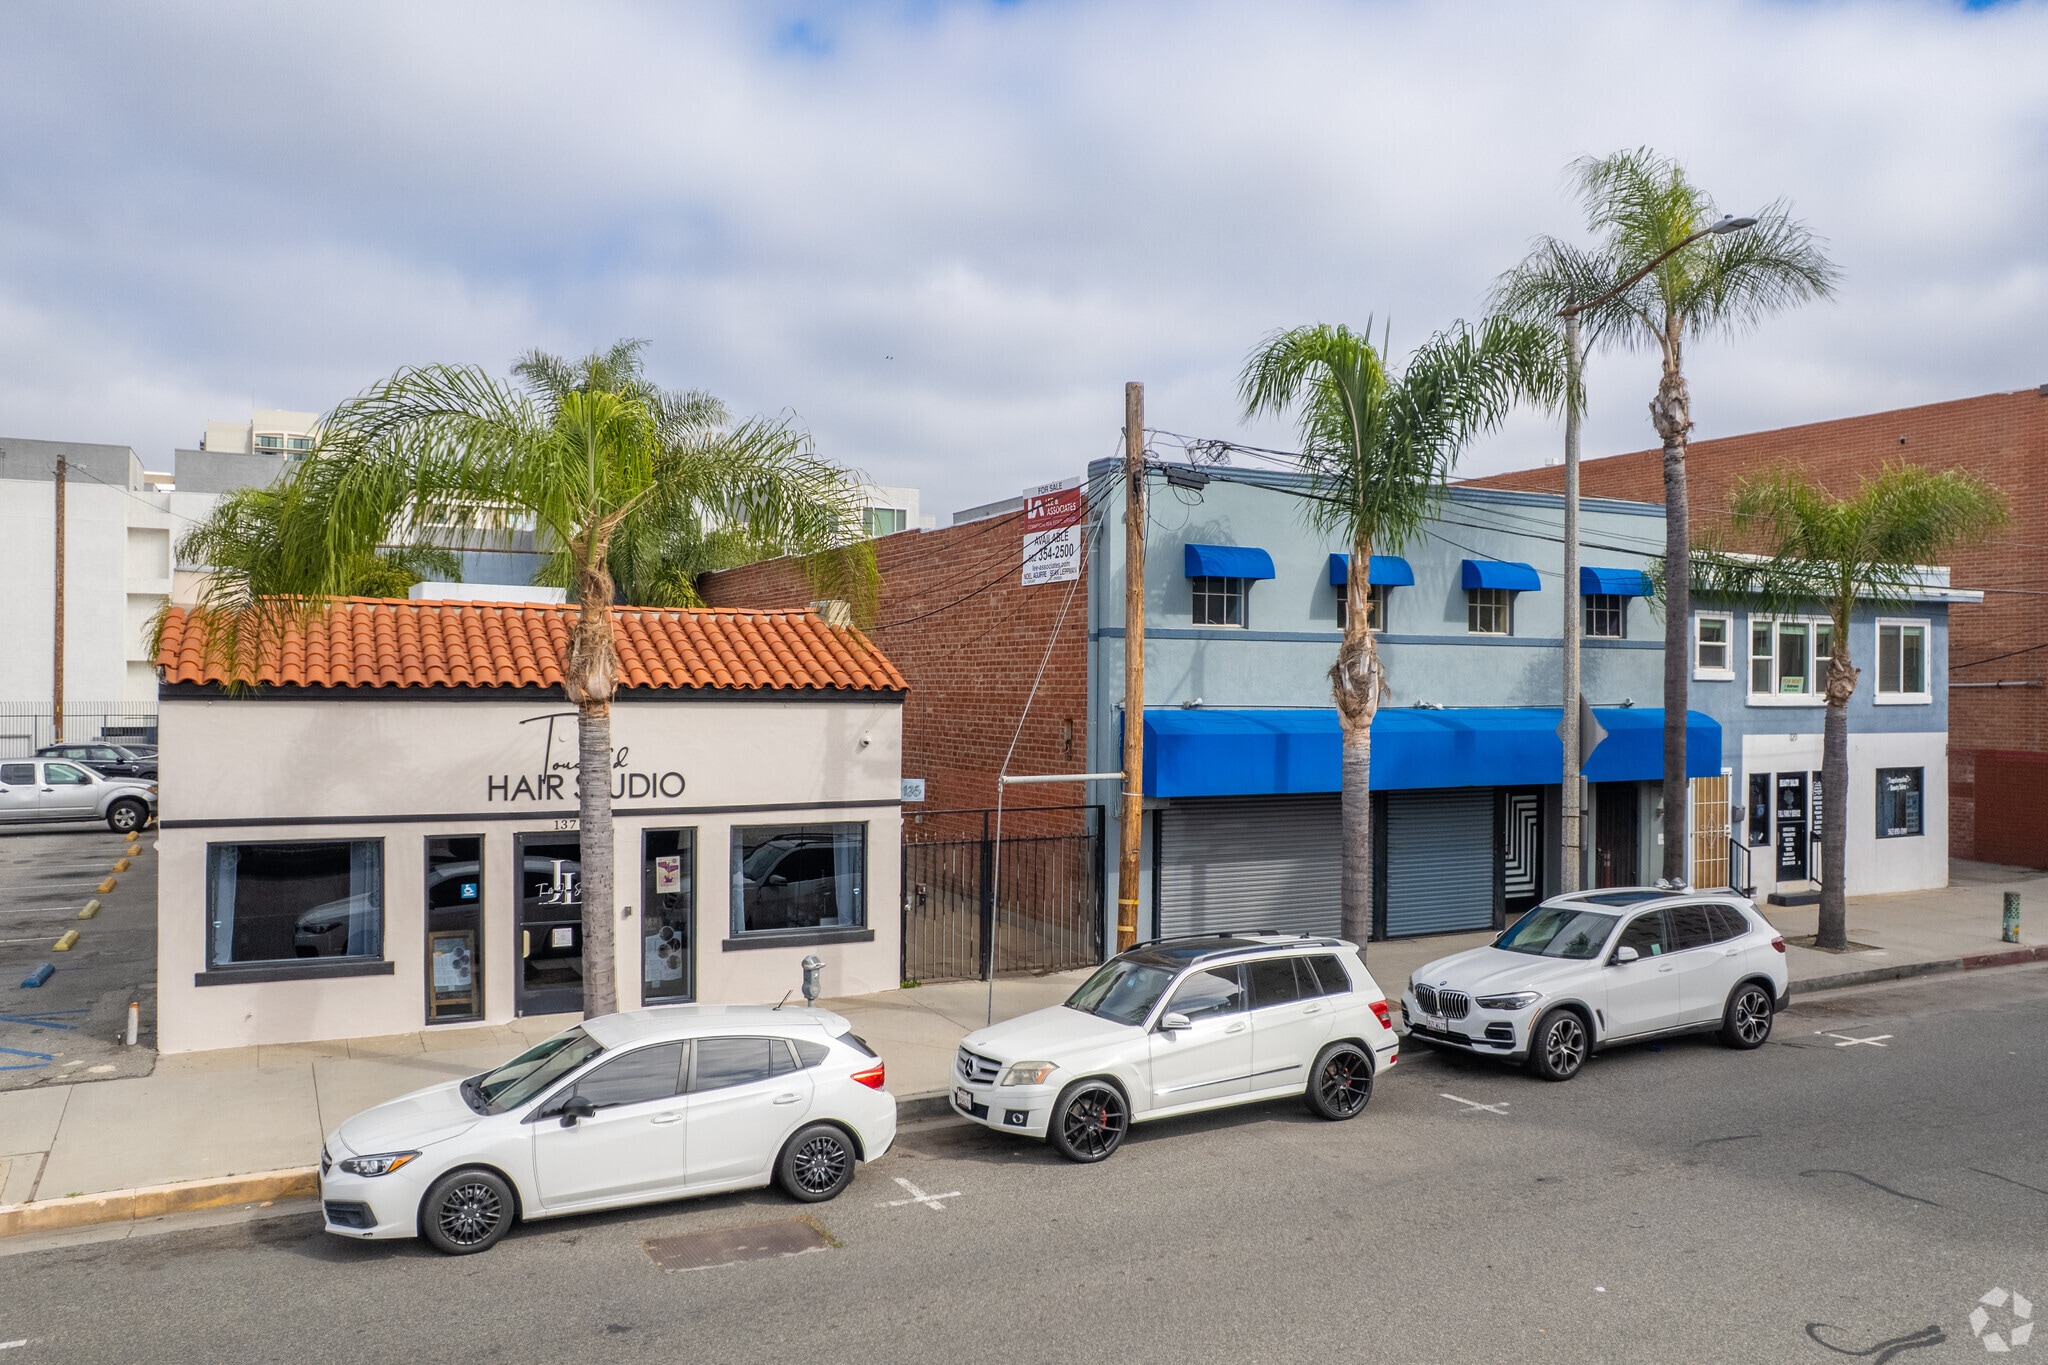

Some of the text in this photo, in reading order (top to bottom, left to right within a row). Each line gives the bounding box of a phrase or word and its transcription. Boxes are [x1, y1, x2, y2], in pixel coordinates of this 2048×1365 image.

[1038, 482, 1062, 494] FOR SALE
[1047, 502, 1076, 516] ASSOCIATES
[1038, 543, 1074, 561] 354-2500
[488, 774, 564, 801] HAIR
[903, 785, 922, 797] 135
[554, 820, 576, 831] 137
